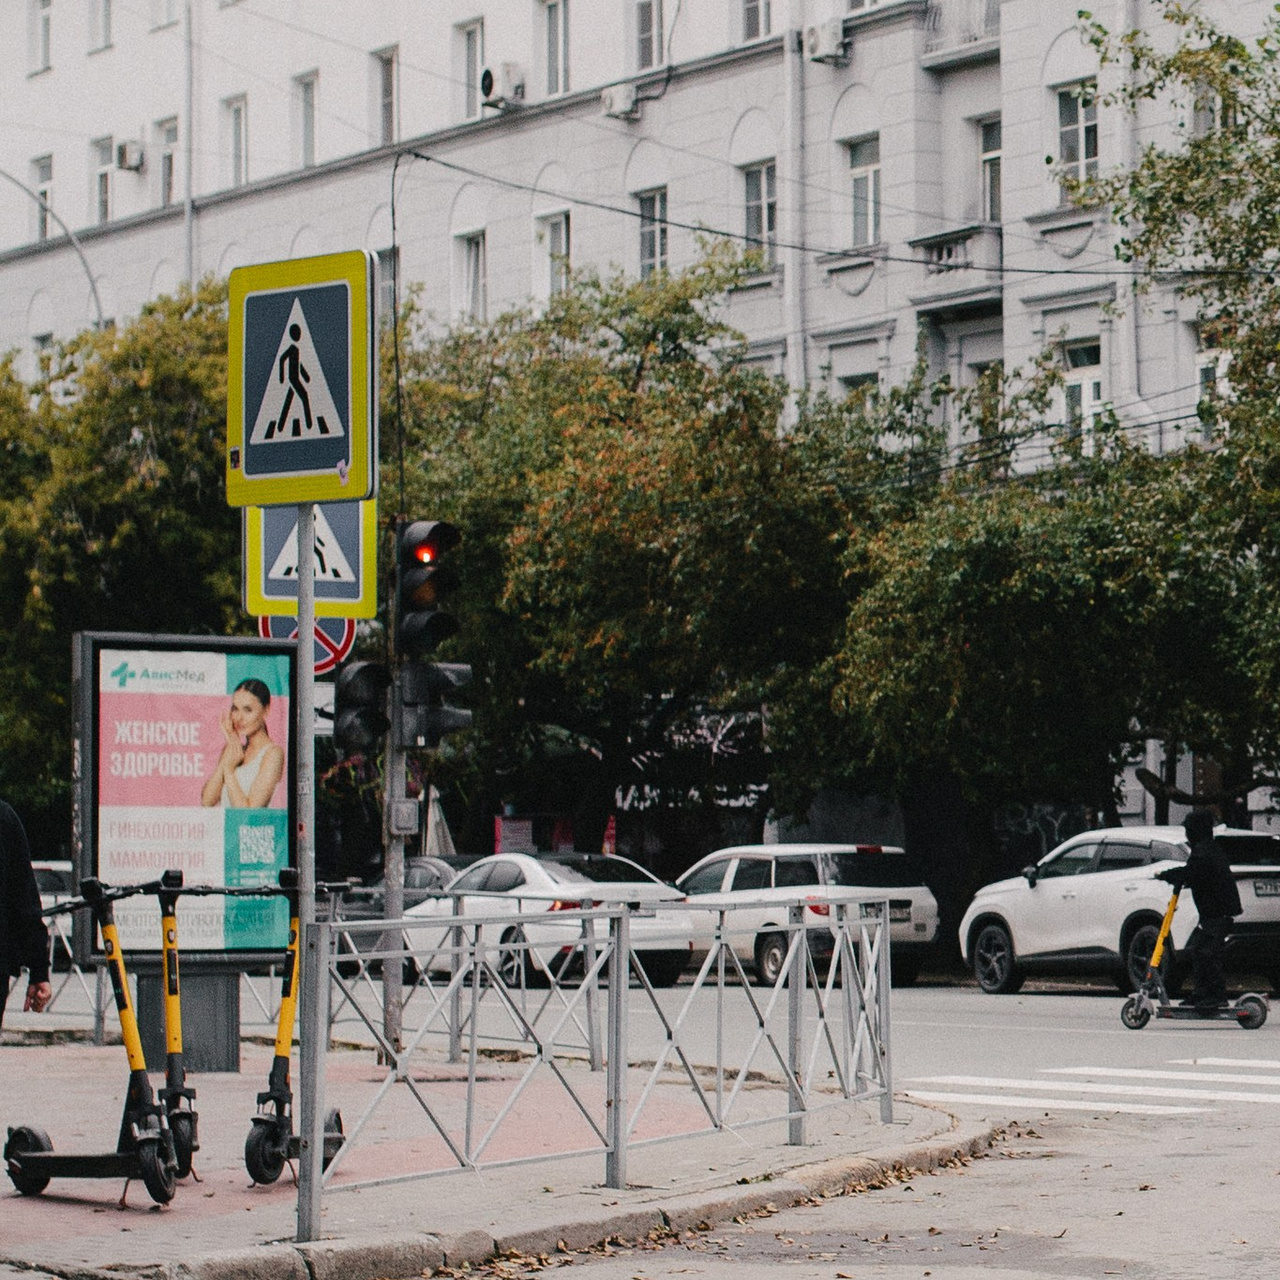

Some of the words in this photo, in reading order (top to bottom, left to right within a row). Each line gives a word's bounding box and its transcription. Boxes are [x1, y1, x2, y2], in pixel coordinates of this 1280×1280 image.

[114, 720, 200, 746] ЖЕНСКОЕ
[110, 751, 205, 778] ЗДОРОВЬЕ
[109, 821, 205, 840] ГИНЕКОЛОГИЯ
[109, 851, 205, 869] МАММОЛОГИЯ
